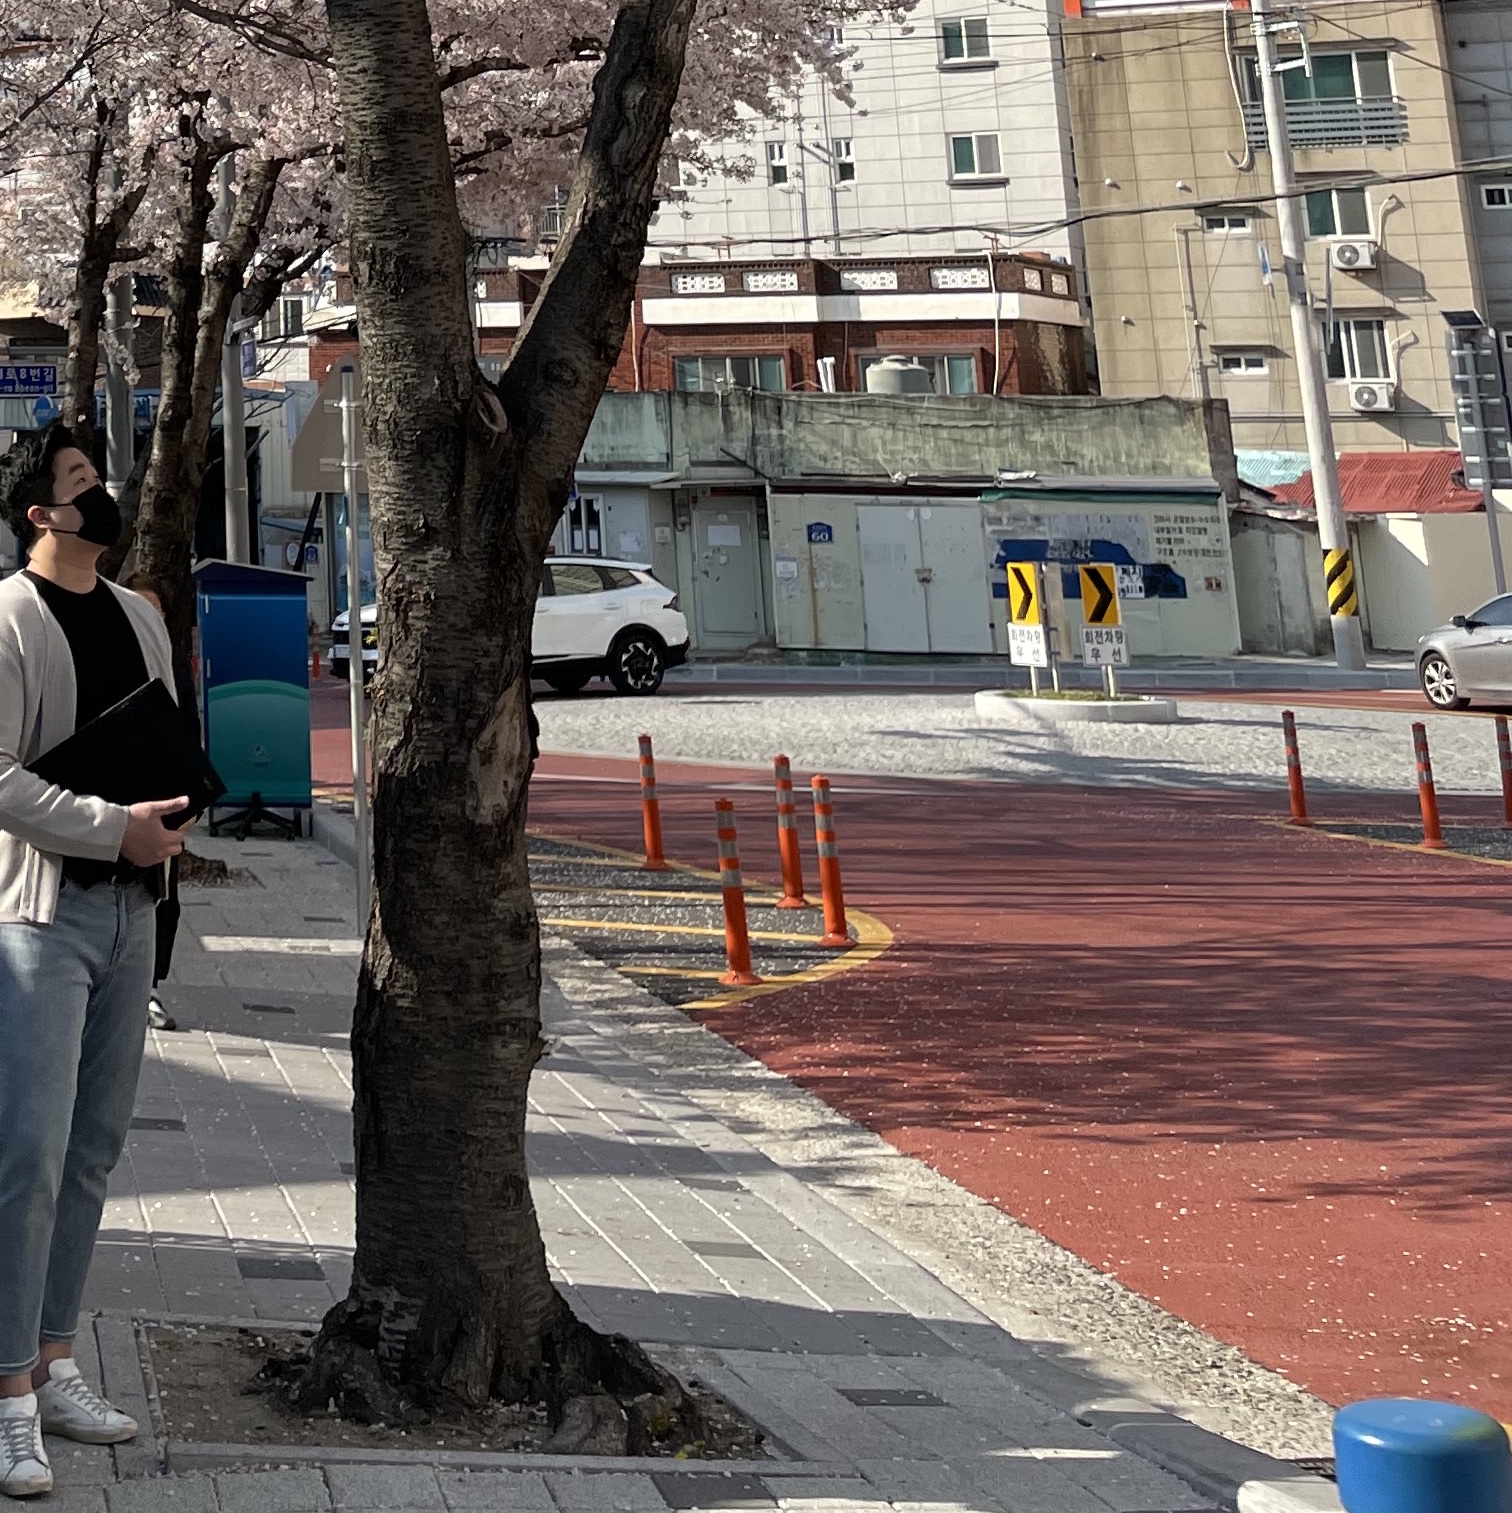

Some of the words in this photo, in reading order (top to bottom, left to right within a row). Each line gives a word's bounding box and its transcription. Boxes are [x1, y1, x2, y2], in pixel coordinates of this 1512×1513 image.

[811, 531, 829, 541] 60
[1011, 628, 1041, 644] 회전차량
[1085, 629, 1123, 645] 회전차량
